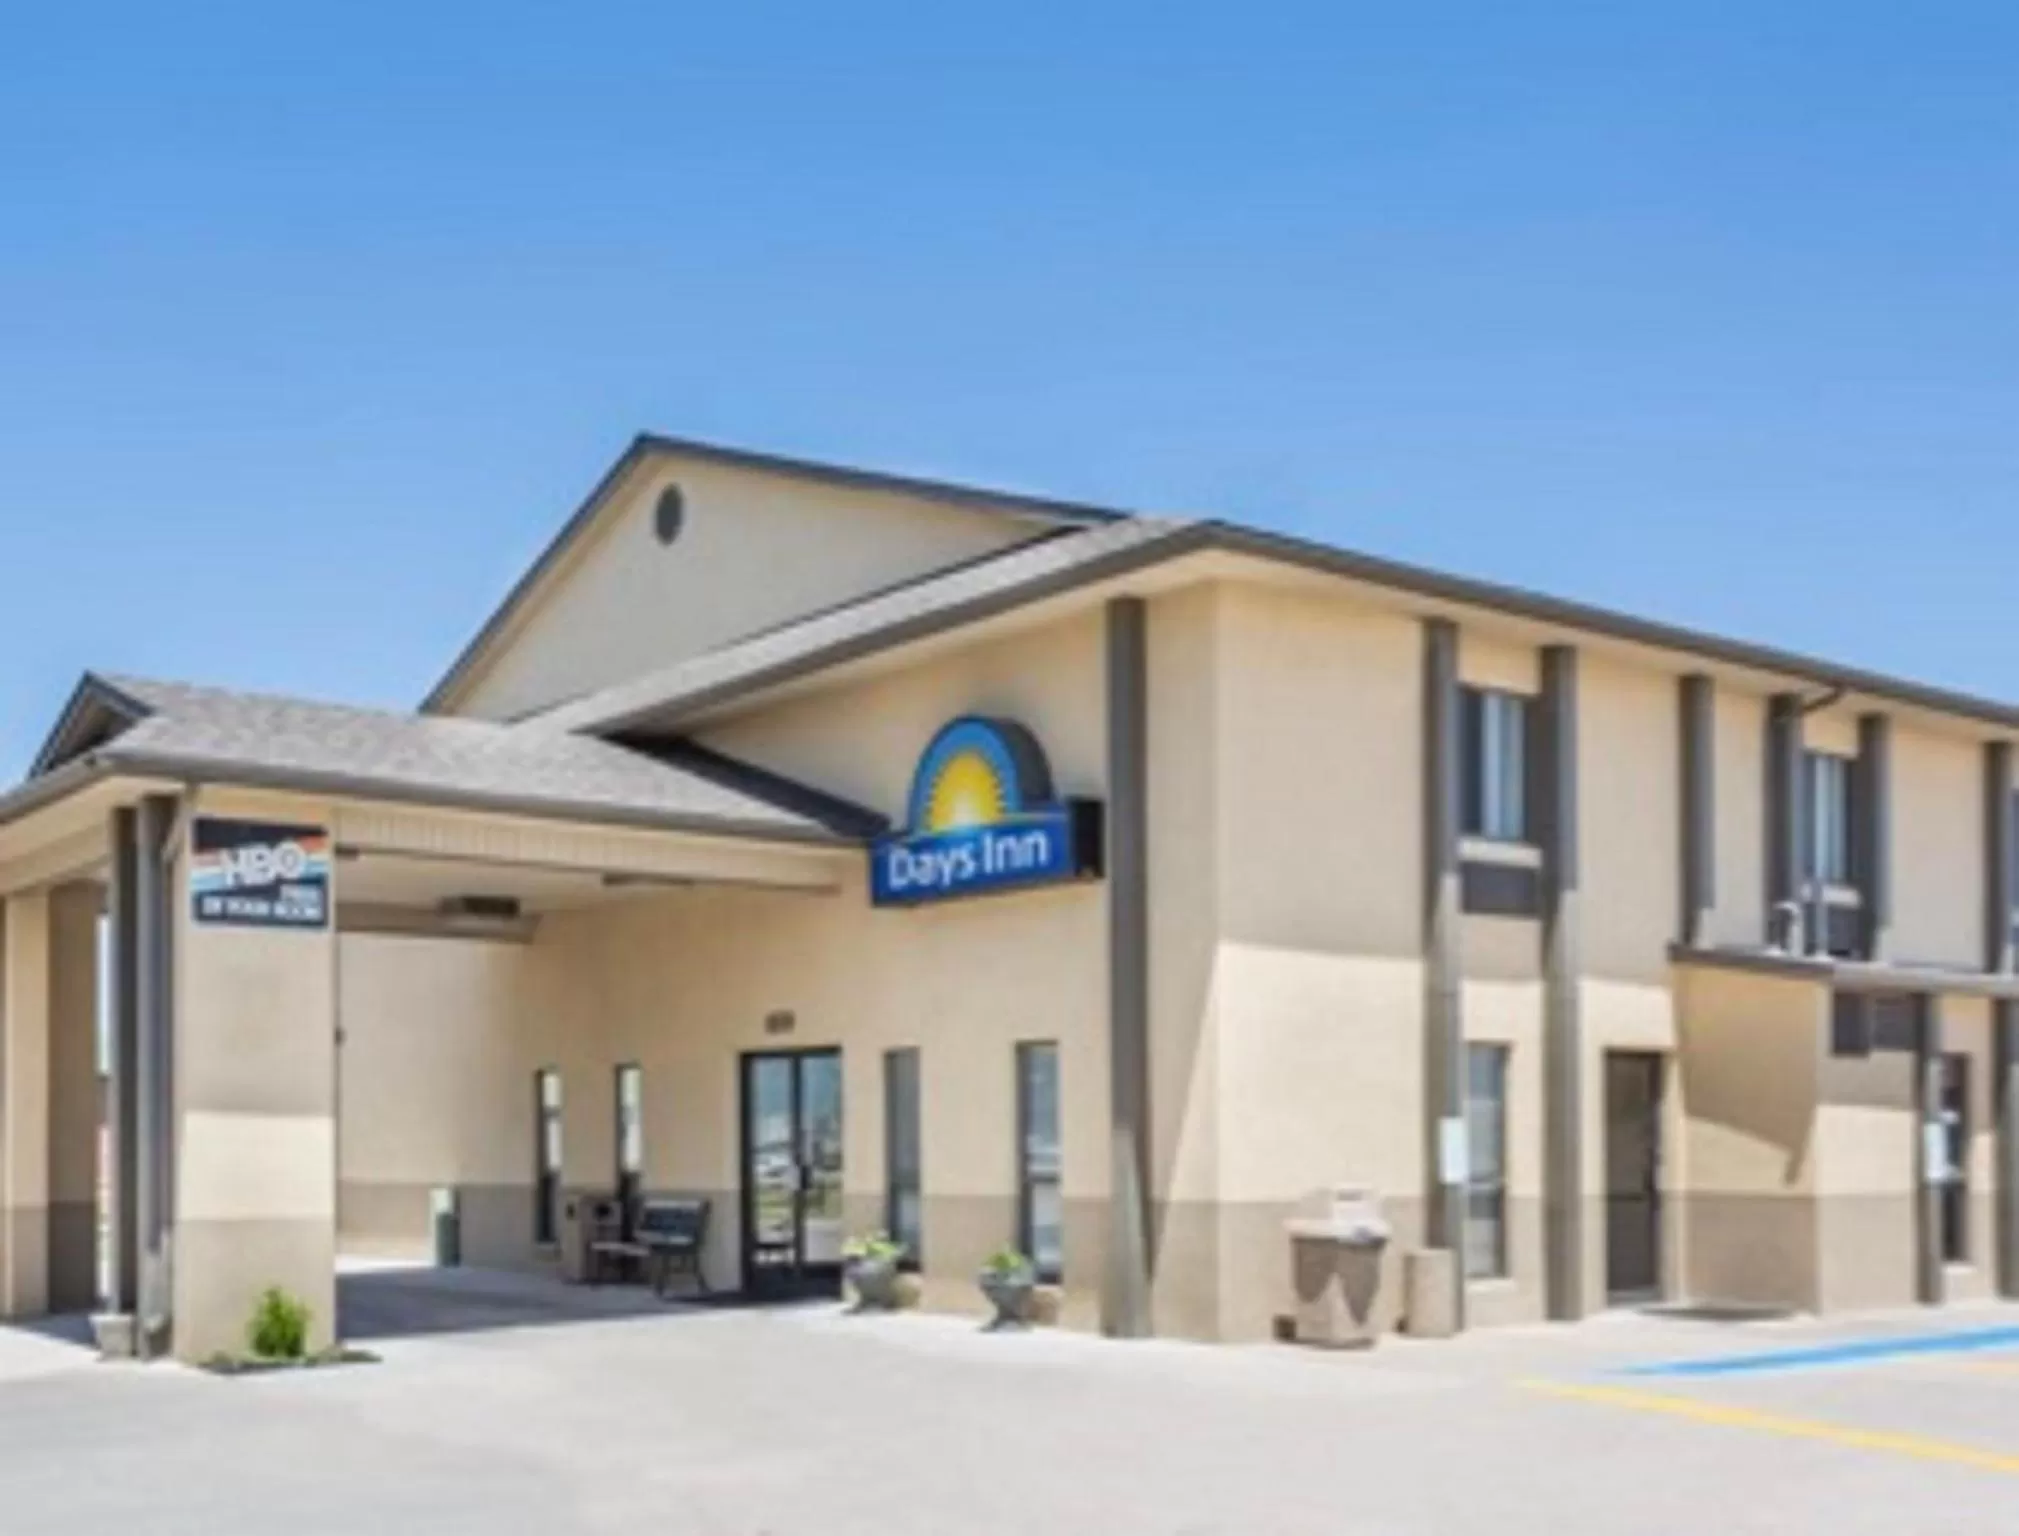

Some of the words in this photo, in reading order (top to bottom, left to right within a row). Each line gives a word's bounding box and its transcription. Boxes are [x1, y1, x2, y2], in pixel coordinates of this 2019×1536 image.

[221, 839, 306, 887] HBO
[888, 842, 976, 891] Days
[982, 829, 1049, 875] Inn
